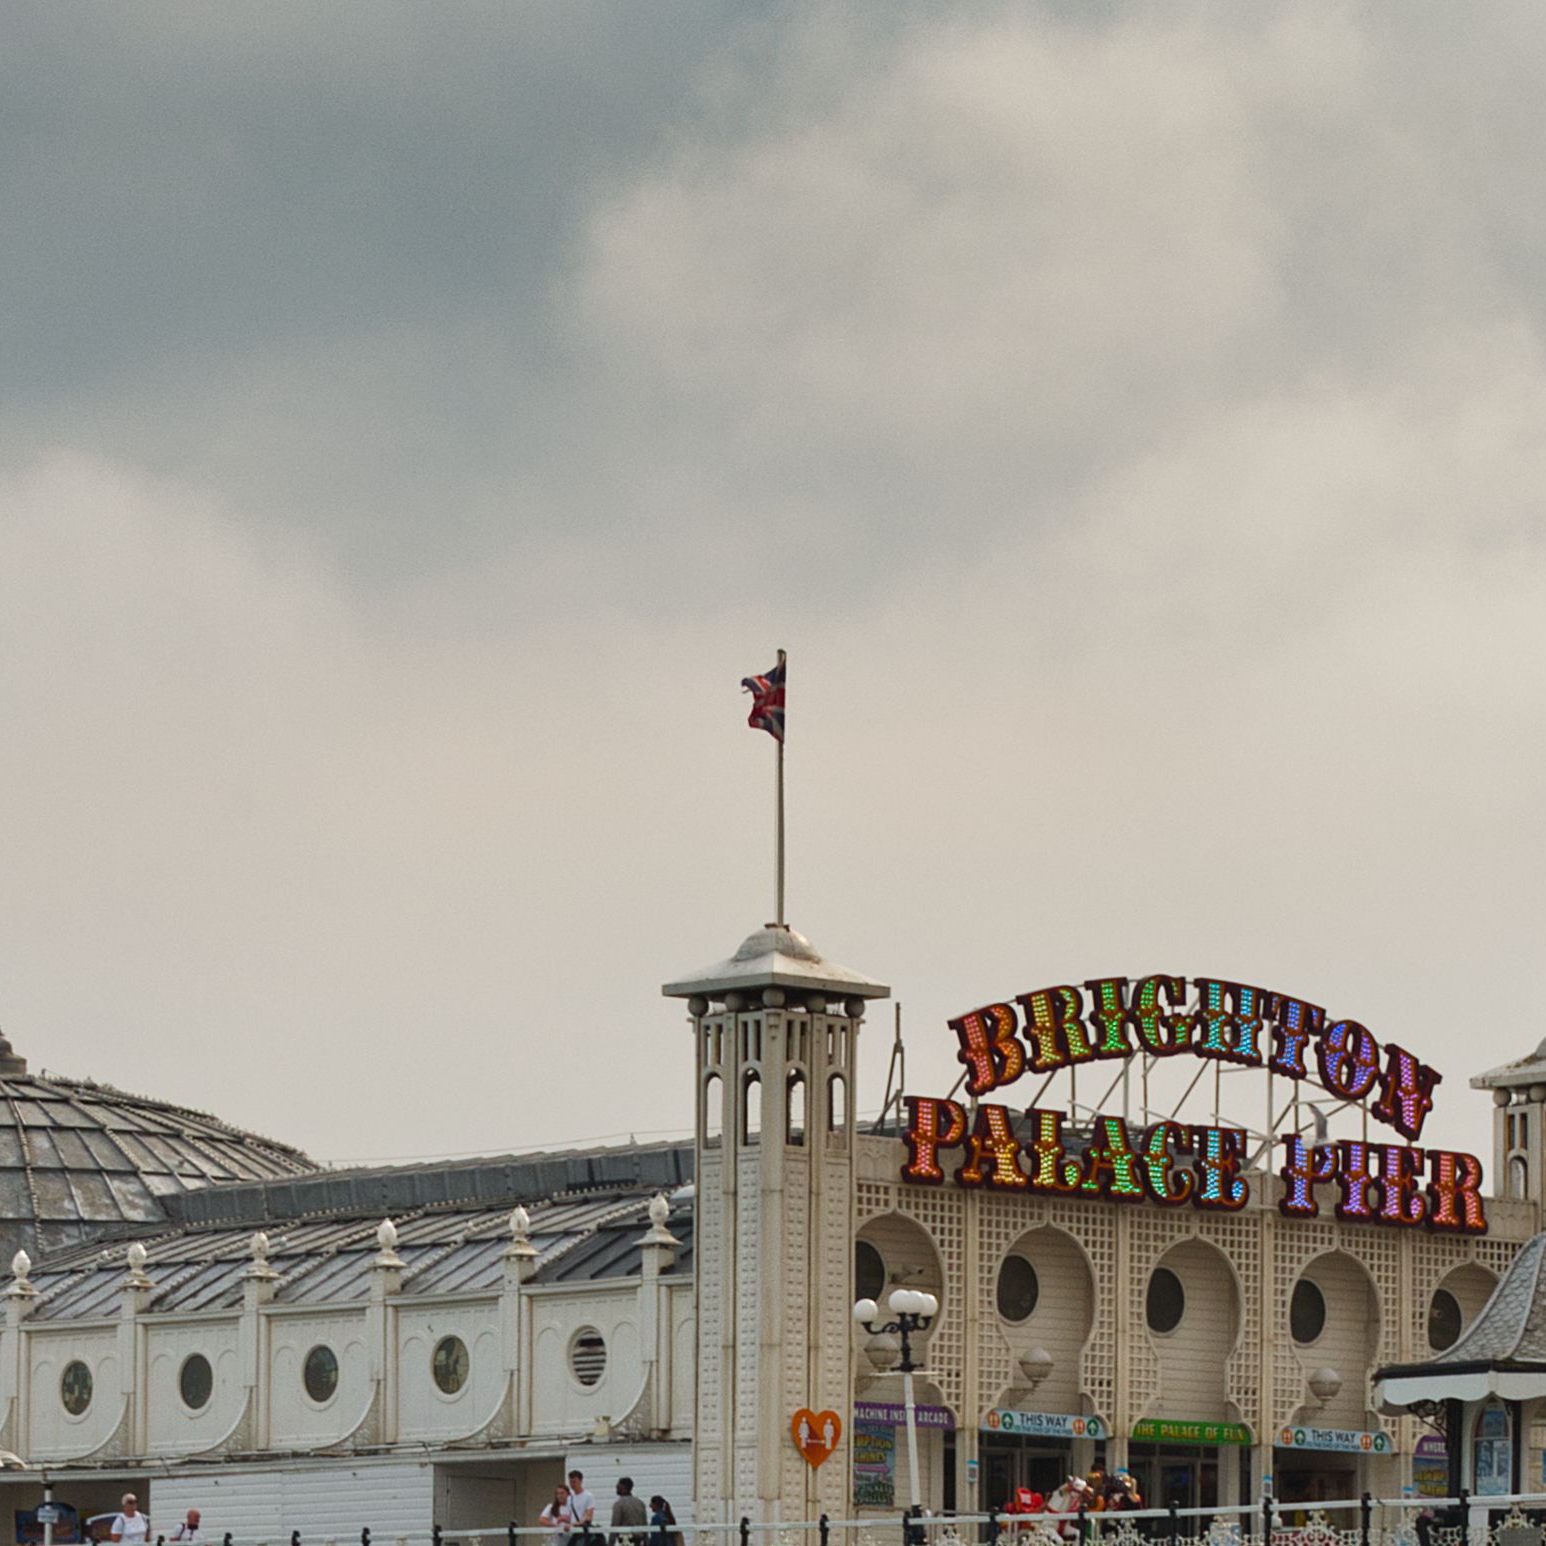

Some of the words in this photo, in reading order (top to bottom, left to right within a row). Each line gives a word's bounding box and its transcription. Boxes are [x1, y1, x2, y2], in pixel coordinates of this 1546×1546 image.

[948, 974, 1442, 1142] BRIGHTON
[902, 1096, 1248, 1212] PALACE
[1279, 1132, 1489, 1237] PIER
[917, 1411, 949, 1425] ARCADE
[1019, 1412, 1043, 1427] THIS
[1045, 1415, 1068, 1428] WAY
[1136, 1423, 1156, 1437] THE
[1160, 1424, 1201, 1439] PALACE
[1205, 1426, 1219, 1440] OF
[1311, 1429, 1333, 1442] THIS
[1334, 1432, 1356, 1444] WAY
